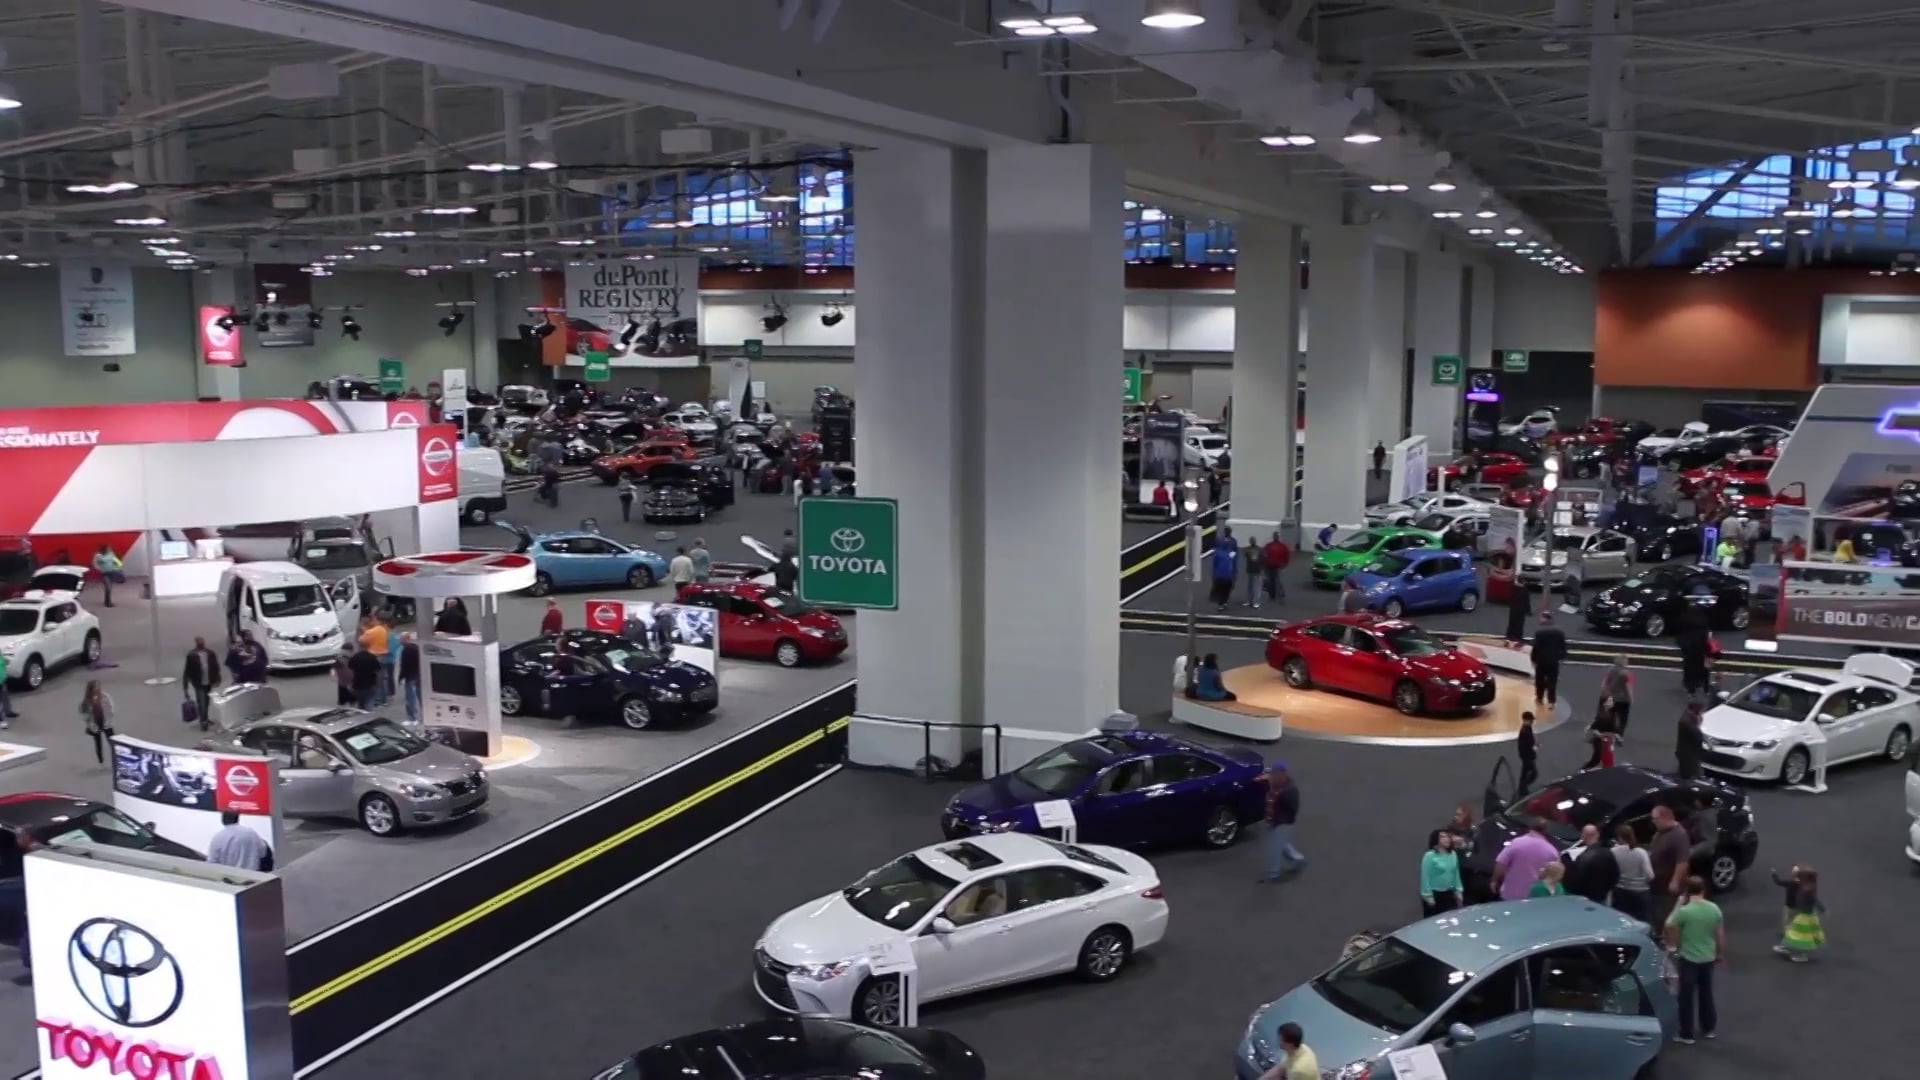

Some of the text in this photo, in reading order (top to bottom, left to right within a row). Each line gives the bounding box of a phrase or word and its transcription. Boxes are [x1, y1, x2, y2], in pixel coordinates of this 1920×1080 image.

[593, 265, 669, 287] duPont
[578, 287, 685, 309] REGISTRY
[807, 555, 887, 575] TOYOTA
[1823, 610, 1868, 627] BOLD
[35, 1017, 223, 1080] TOYOTA
